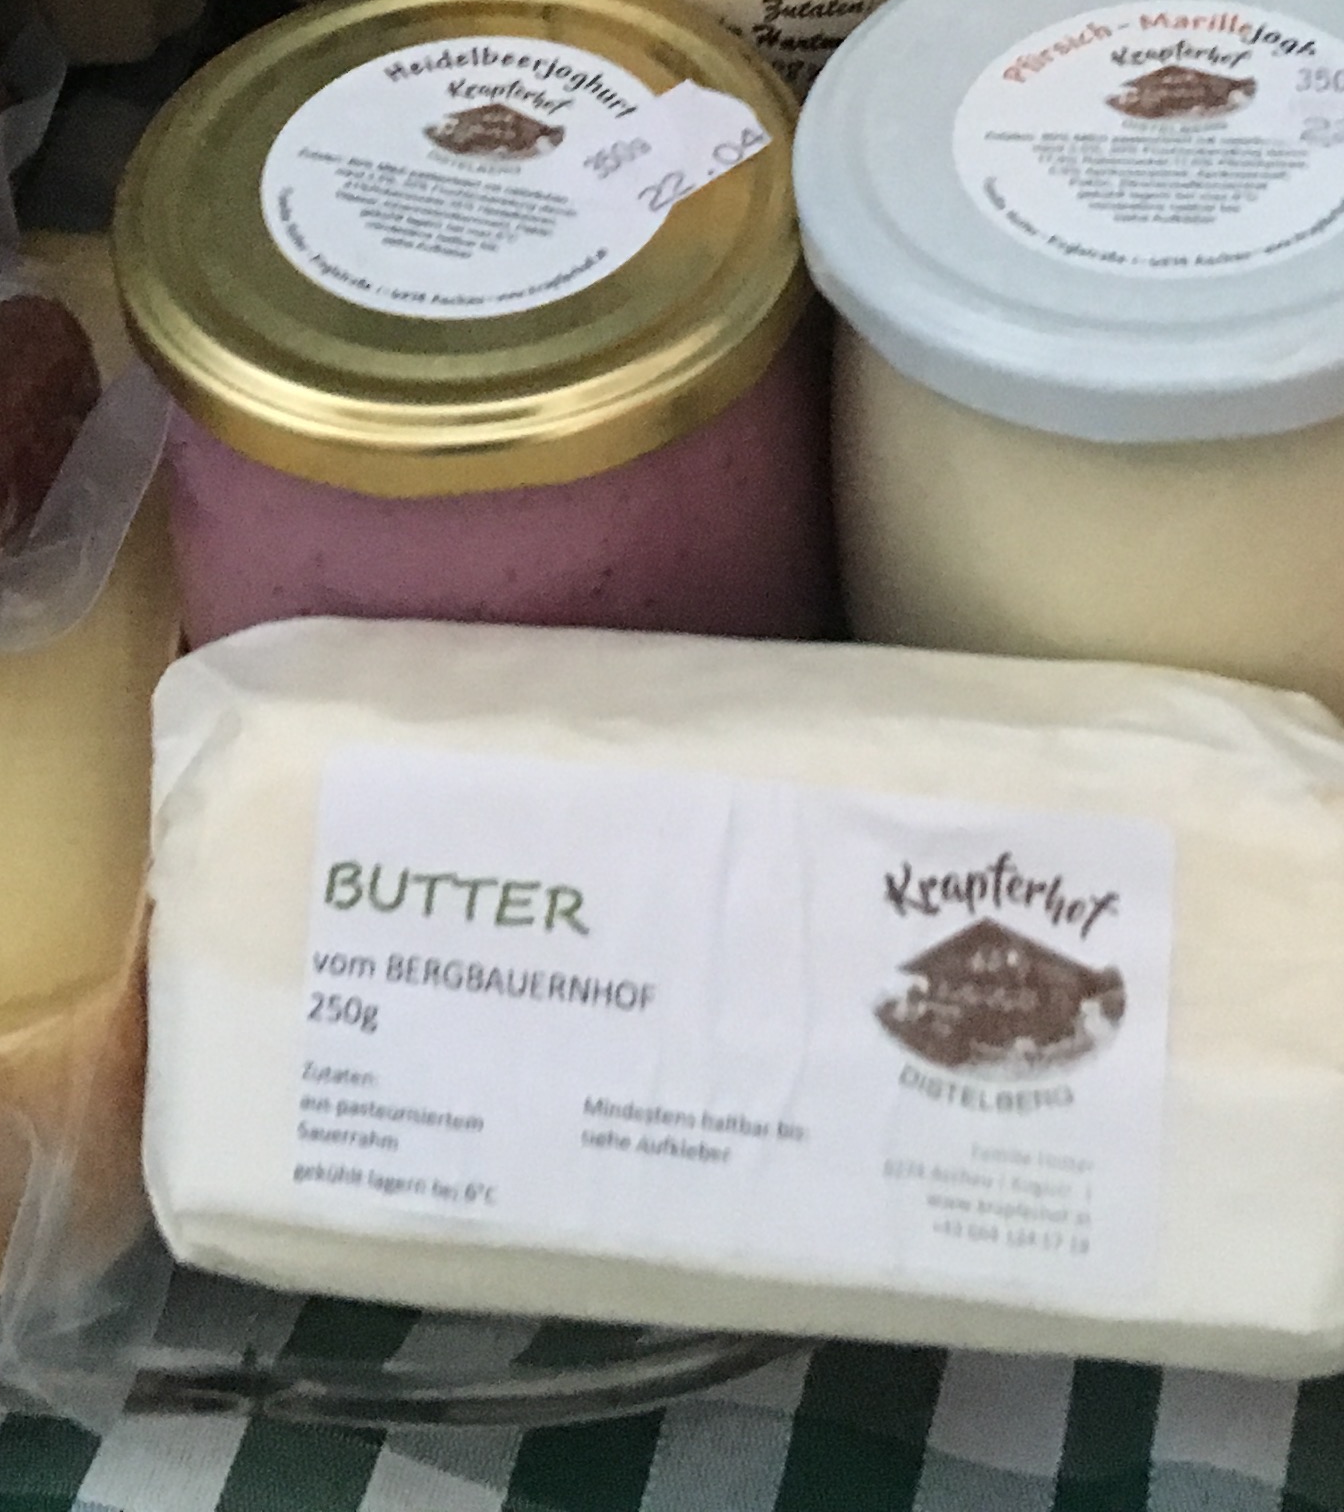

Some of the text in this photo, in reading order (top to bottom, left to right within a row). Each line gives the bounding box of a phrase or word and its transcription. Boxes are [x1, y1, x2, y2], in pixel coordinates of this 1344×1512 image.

[383, 45, 639, 120] Heidelbeerjoghurt
[446, 77, 577, 117] Krapferhof
[323, 860, 592, 938] BUTTER
[883, 849, 1121, 942] Krapferhof
[311, 949, 658, 1014] vom BERGBAUERNHOF
[305, 989, 380, 1036] 250g
[582, 1094, 697, 1130] Mindestens
[700, 1109, 769, 1138] haltbar
[580, 1128, 732, 1164] siehe Aufkleber
